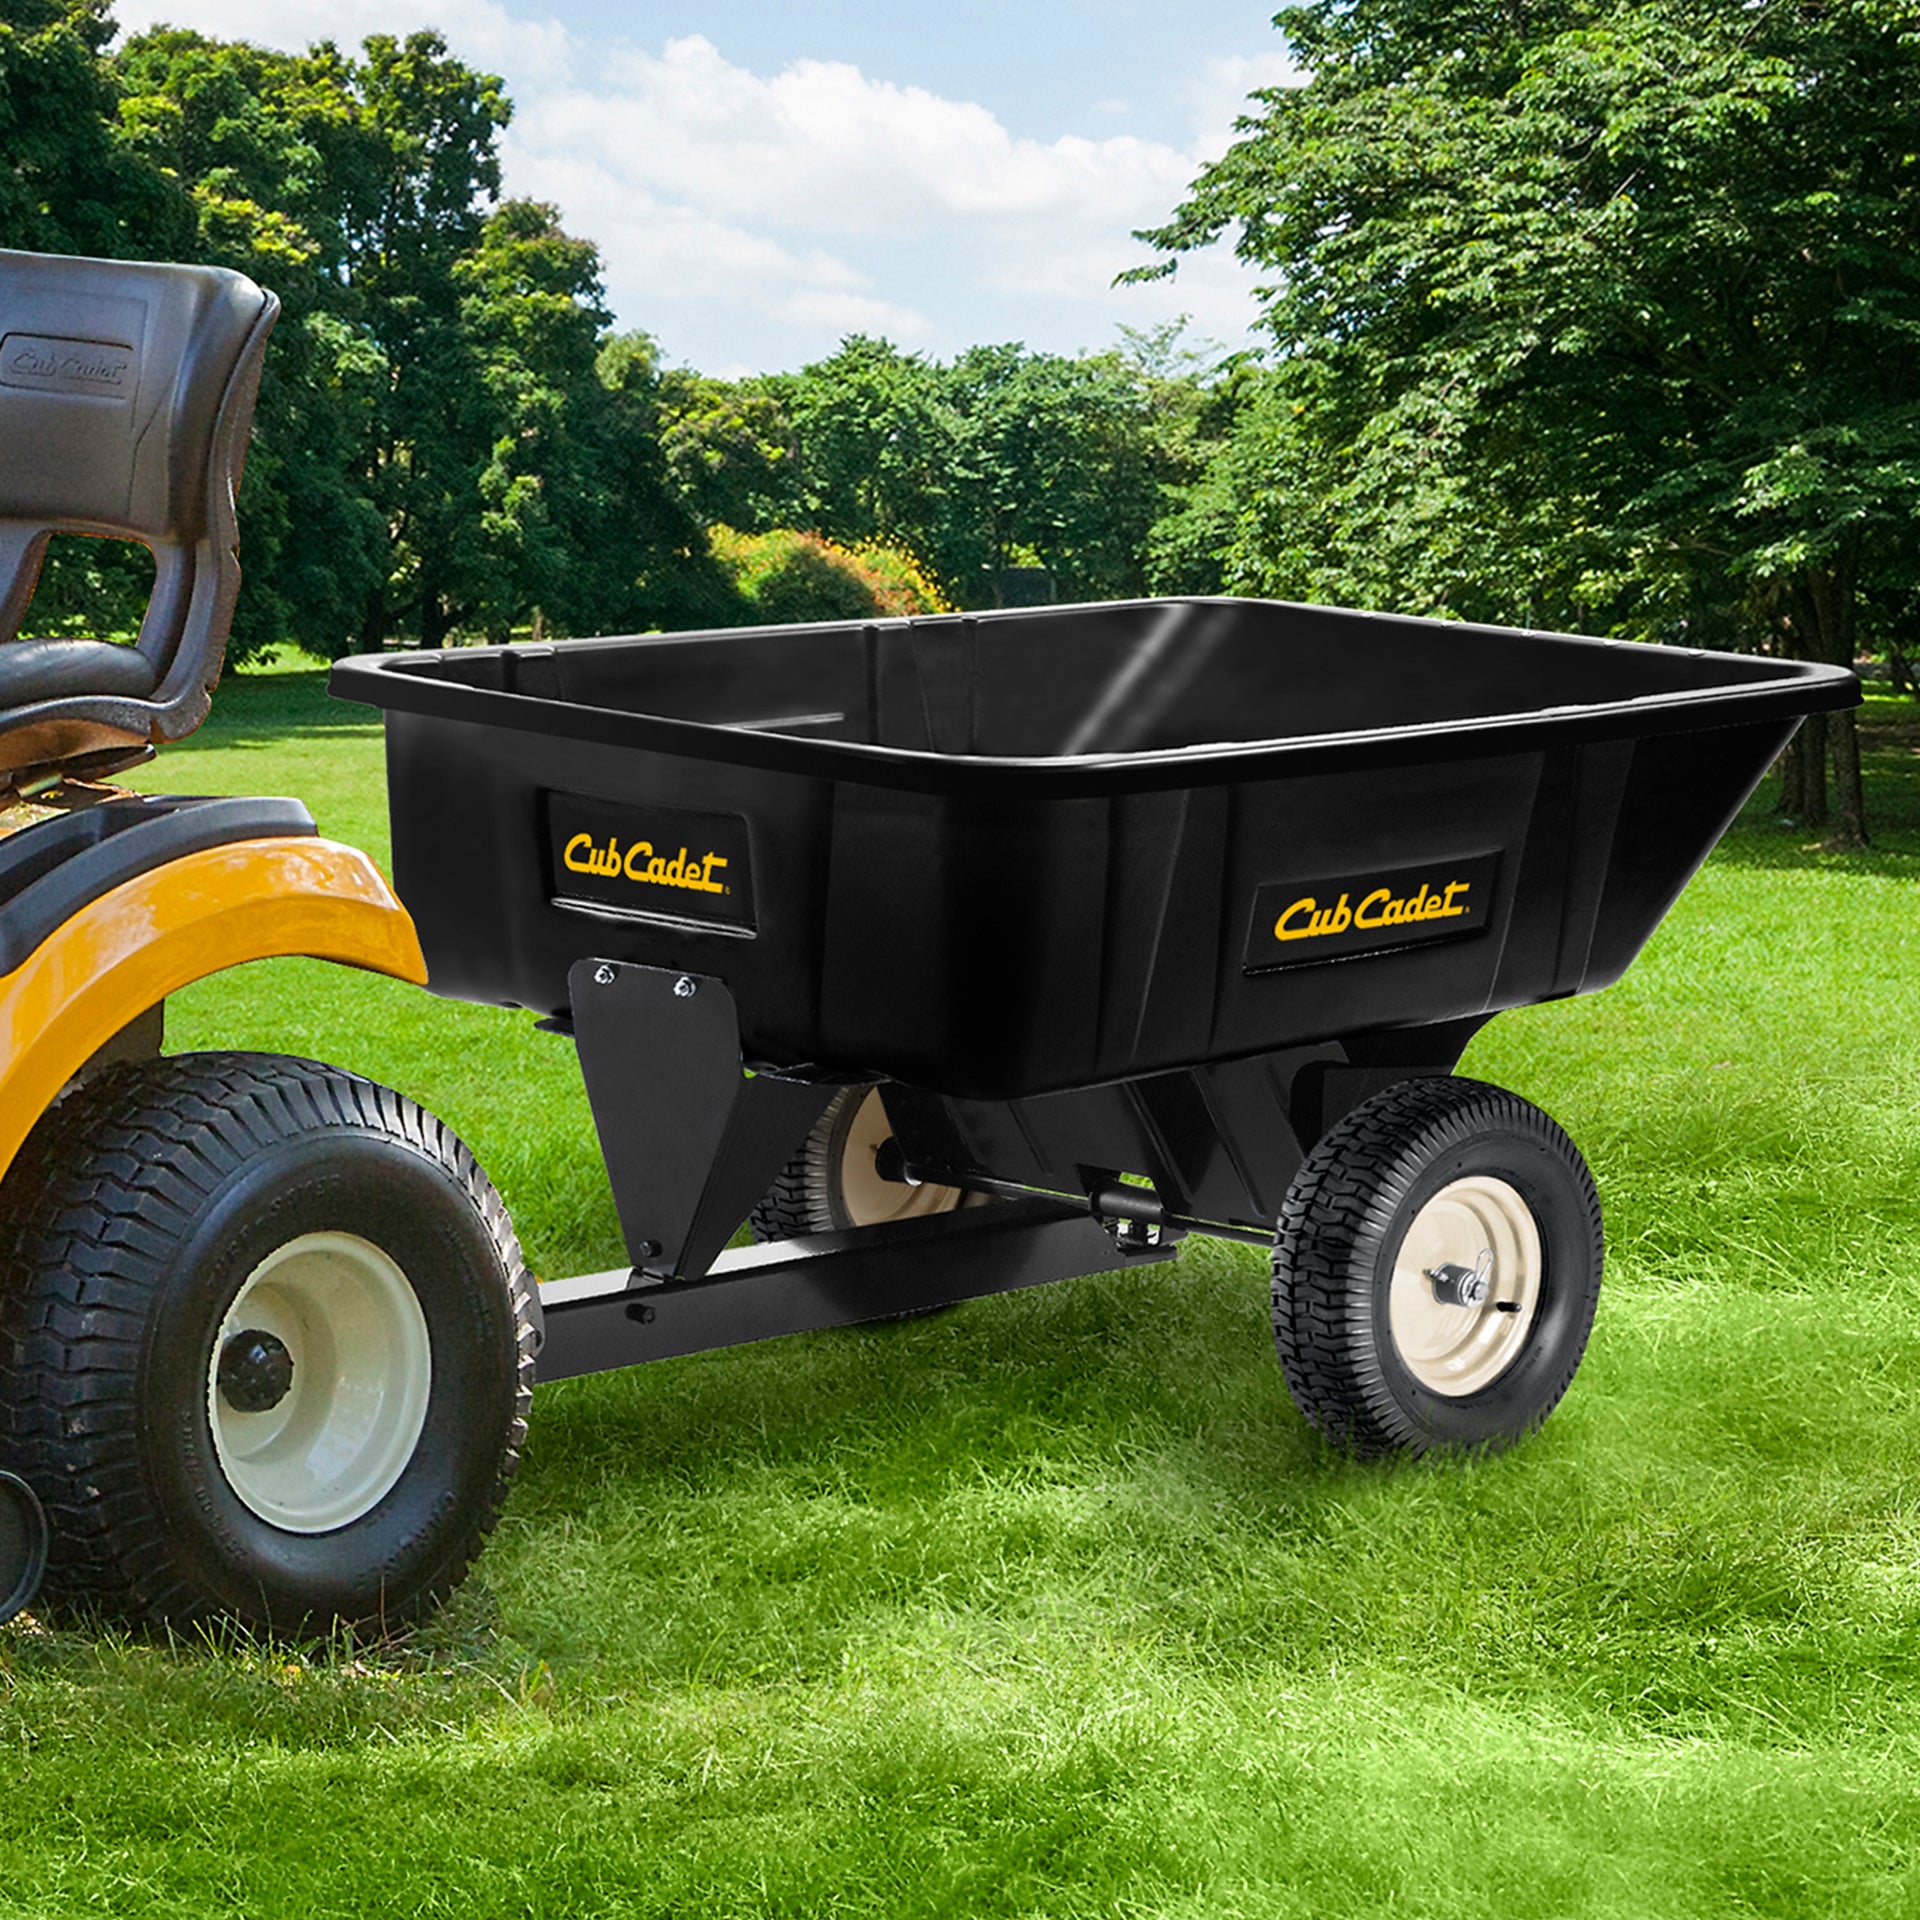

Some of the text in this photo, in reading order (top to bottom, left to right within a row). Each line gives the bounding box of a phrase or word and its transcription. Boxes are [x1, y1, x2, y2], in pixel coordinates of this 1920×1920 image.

[9, 350, 58, 377] Cub
[563, 832, 727, 893] Cub Cadet
[1274, 880, 1470, 941] Cub Cadet
